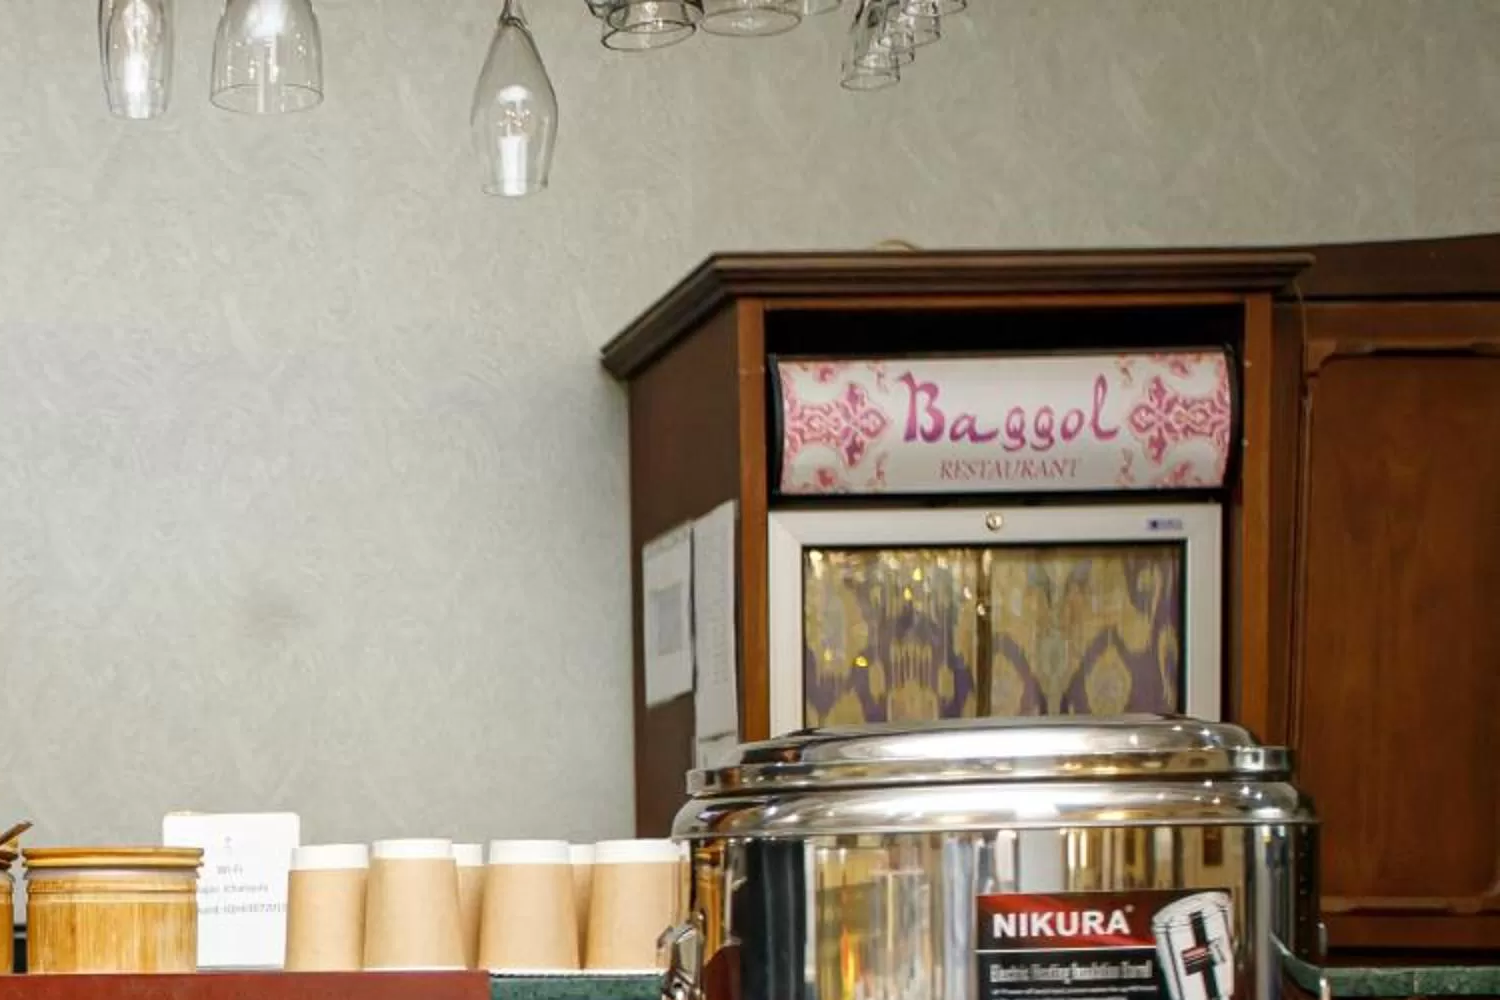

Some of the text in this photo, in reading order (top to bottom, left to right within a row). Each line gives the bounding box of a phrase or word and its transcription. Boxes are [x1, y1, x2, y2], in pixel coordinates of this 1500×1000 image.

[897, 371, 1120, 451] Baggol
[939, 457, 1080, 481] RESTAURANT
[992, 909, 1132, 938] NIKURA
